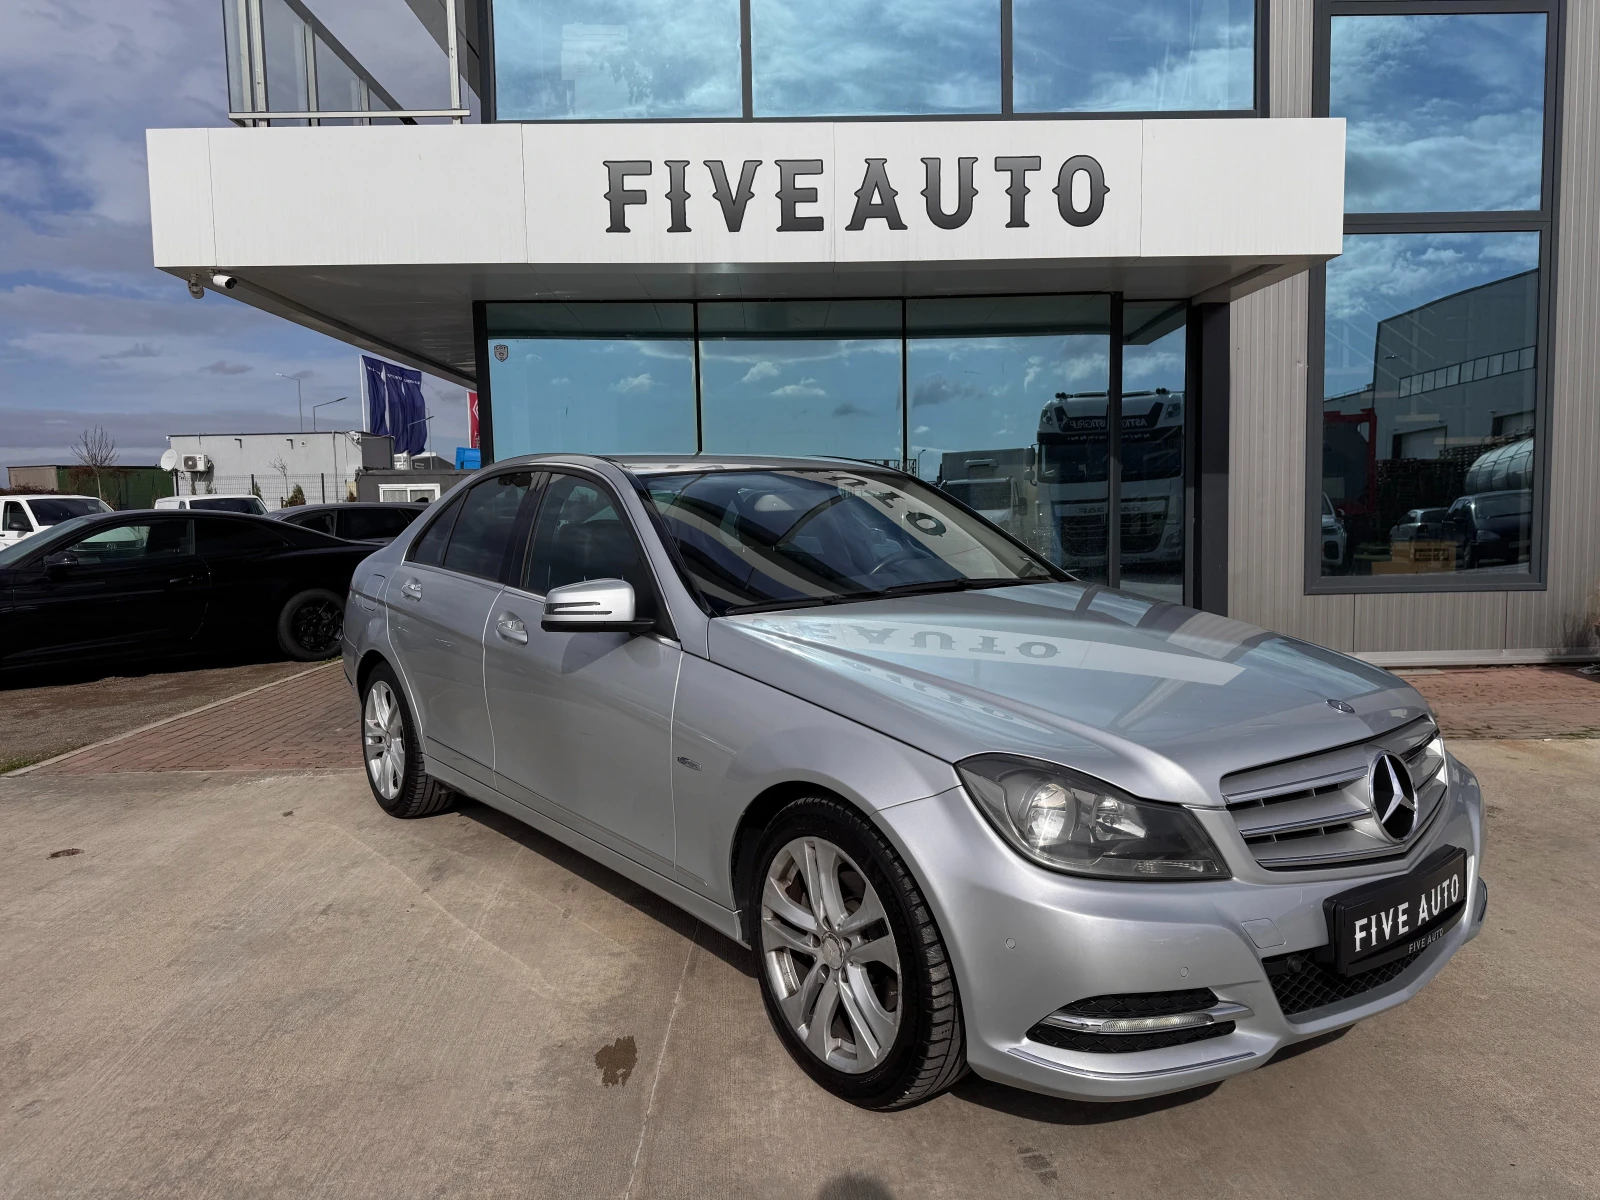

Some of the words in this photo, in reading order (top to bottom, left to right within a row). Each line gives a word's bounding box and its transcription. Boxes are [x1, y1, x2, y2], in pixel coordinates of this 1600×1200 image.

[1354, 902, 1409, 952] FIVE
[1418, 873, 1459, 926] AUTO
[1408, 938, 1426, 954] FIVE
[1427, 927, 1444, 945] AUTO
